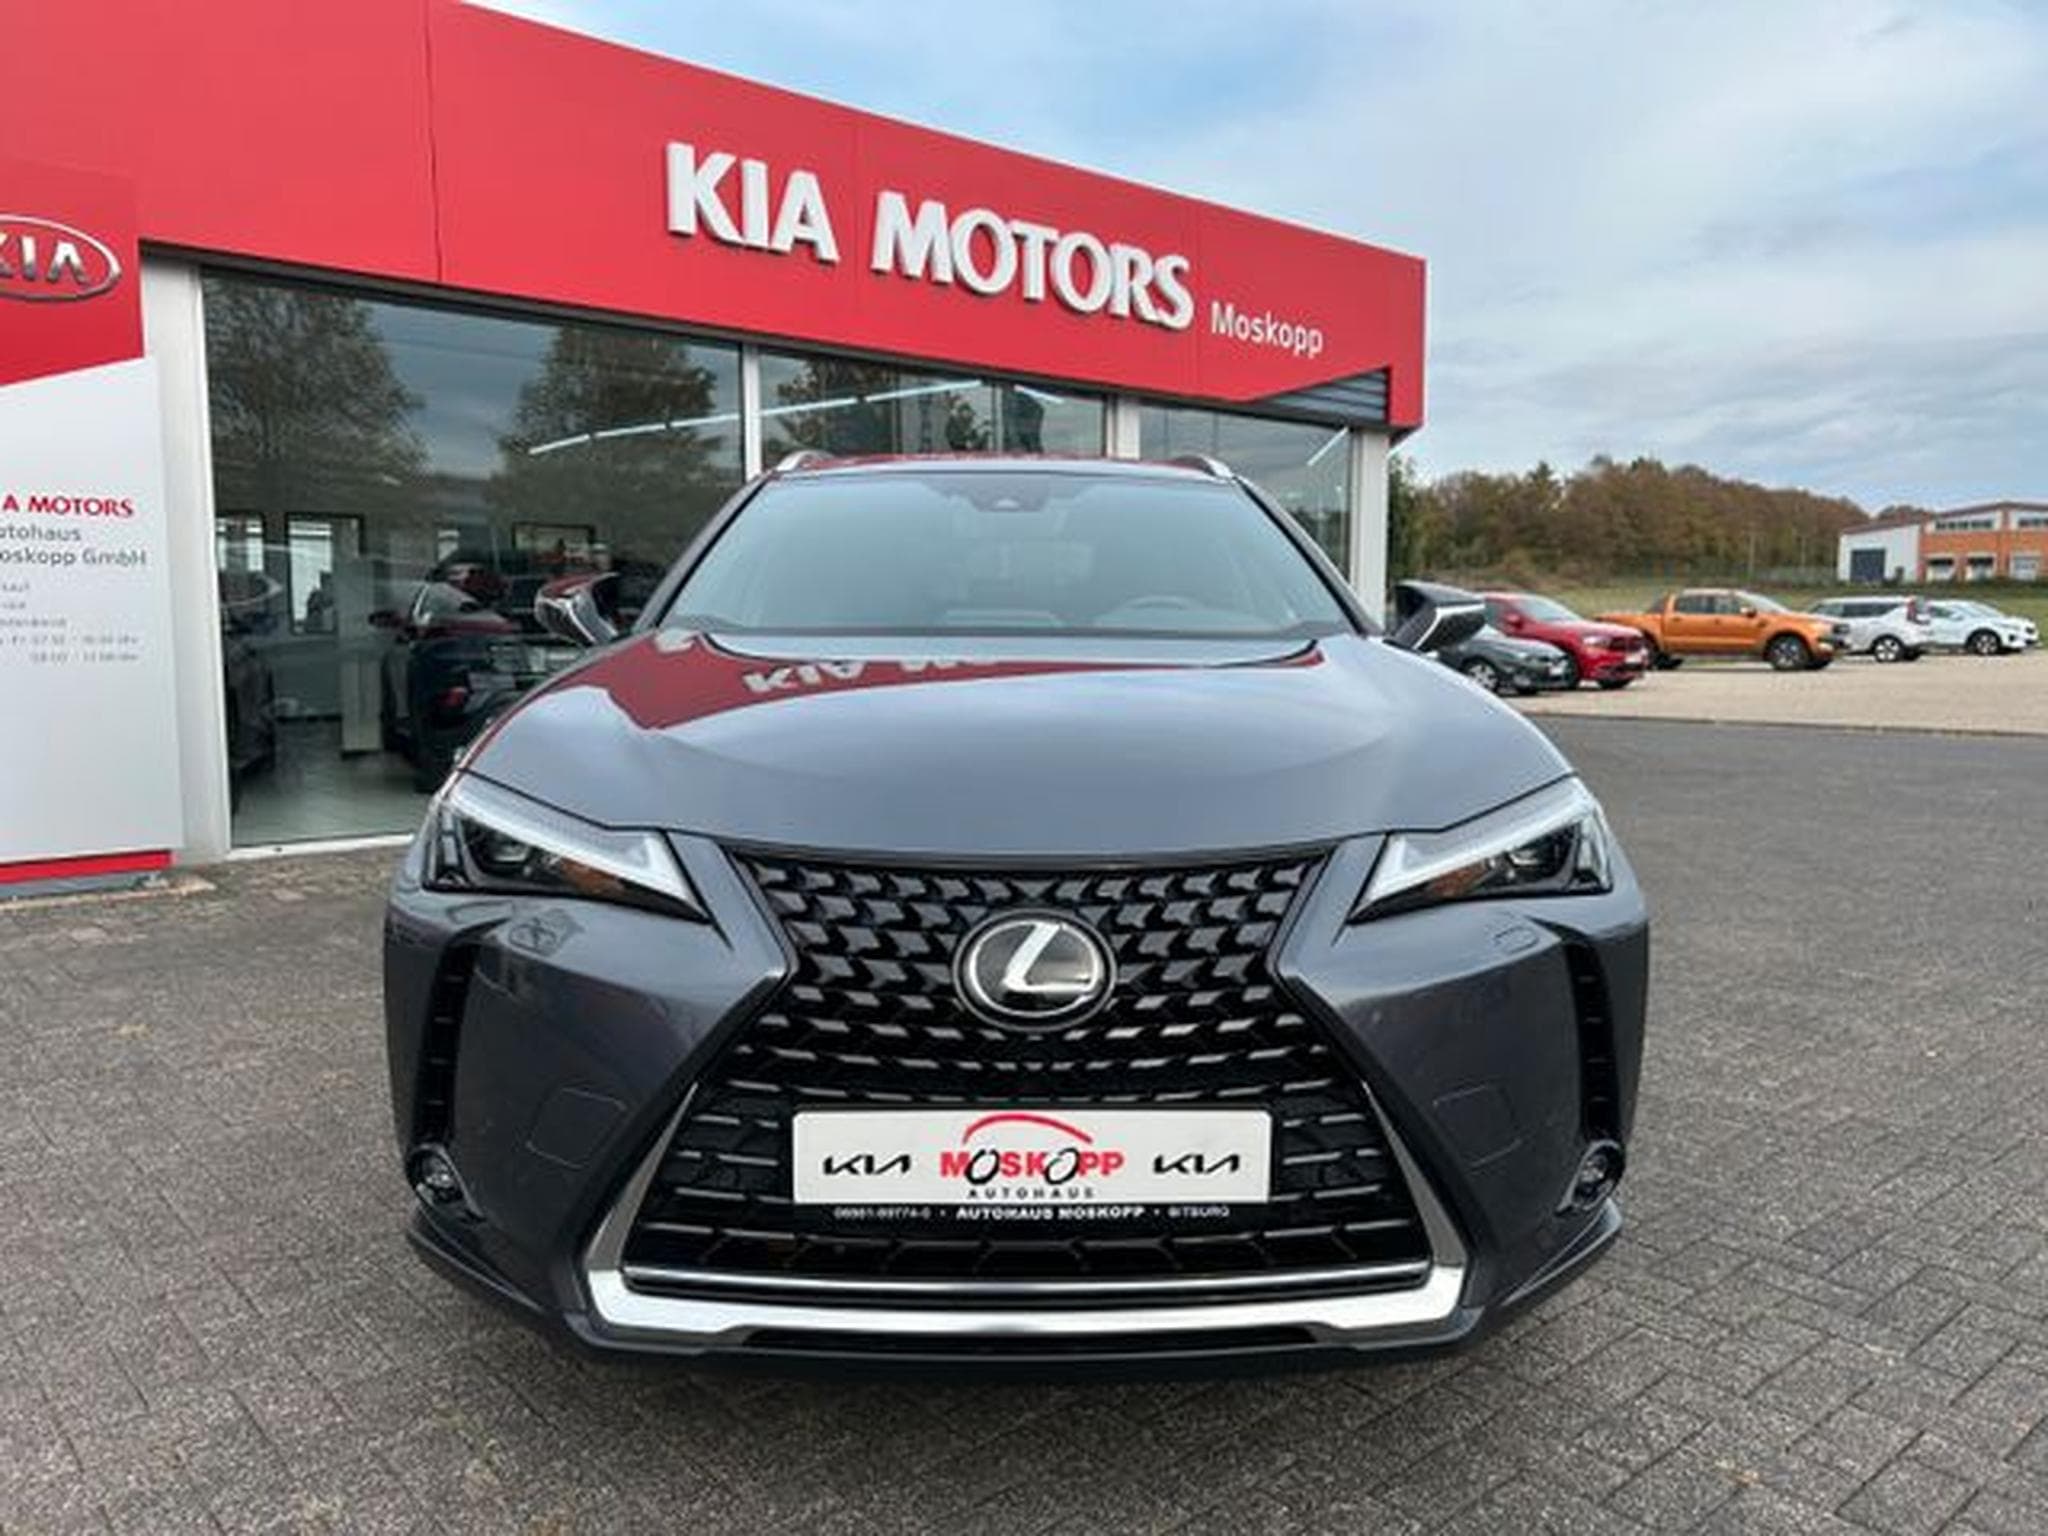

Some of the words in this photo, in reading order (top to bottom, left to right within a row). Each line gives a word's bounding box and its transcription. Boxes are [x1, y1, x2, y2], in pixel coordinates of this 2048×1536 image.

[667, 142, 839, 262] KIA
[872, 190, 1194, 329] MOTORS
[1211, 301, 1323, 357] Moskopp
[28, 496, 134, 516] MOTORS
[82, 550, 147, 567] GmbH
[823, 1154, 911, 1176] KIA
[940, 1148, 1125, 1185] MOSKOPP
[1153, 1153, 1240, 1175] KIA
[968, 1187, 1094, 1199] AUTOHAUS
[956, 1206, 1053, 1220] AUTOHAUS
[1057, 1205, 1145, 1220] MOSKOPP
